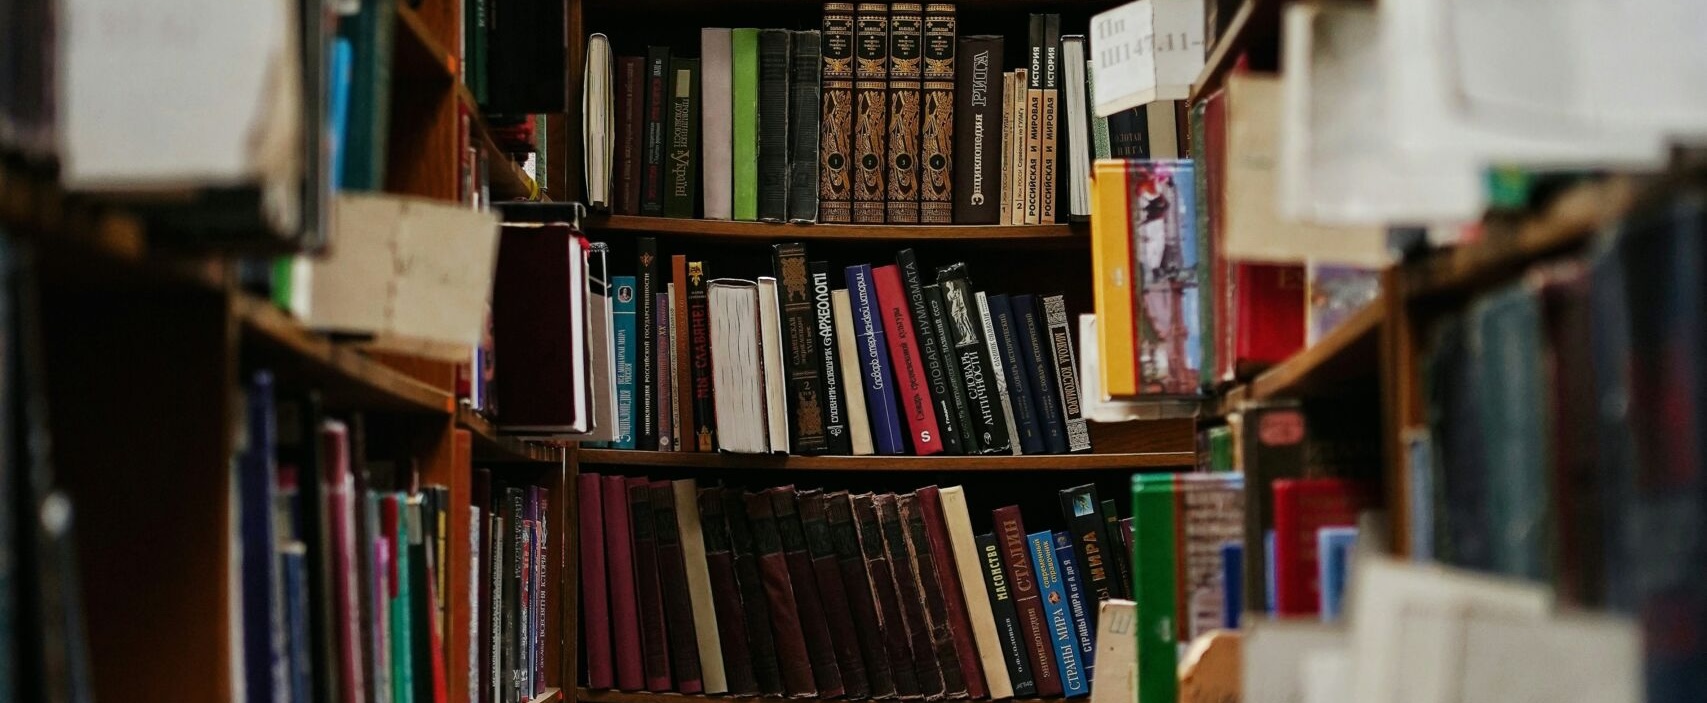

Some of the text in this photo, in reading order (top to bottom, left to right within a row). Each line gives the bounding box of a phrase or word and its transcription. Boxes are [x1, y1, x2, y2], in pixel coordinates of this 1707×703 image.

[1032, 47, 1040, 87] ИСТОРИЯ
[1047, 47, 1055, 87] ИСТОРИЯ
[971, 50, 988, 205] Энциклопедия РИГА
[671, 150, 690, 196] Україні
[1029, 159, 1037, 216] РОССИЙСКАЯ
[1044, 159, 1052, 216] РОССИЙСКАЯ
[1016, 202, 1023, 210] 2
[856, 272, 883, 390] Словарь американской истории
[893, 307, 907, 339] культуры
[905, 262, 945, 394] СЛОВАРЬ НУМИЗМАТА
[931, 300, 940, 316] СССР
[692, 305, 707, 369] СЛАВЯНЕ!
[789, 317, 800, 365] СЛАВЯНСКАЯ
[935, 318, 949, 353] НАЗВАНИЙ
[999, 313, 1022, 392] СЛОВАРЬ ИСТОРИЧЕСКИЙ
[1025, 313, 1042, 363] ИСТОРИЧЕСКИЙ
[803, 380, 811, 391] 2
[824, 347, 838, 423] СЛОВНИК-ДОВІДНИК
[961, 352, 978, 399] СЛОВАРЬ
[969, 351, 993, 425] АНТИЧНОСТИ
[1055, 332, 1079, 415] МИКОЛА КОСТОМАРОВ
[920, 430, 931, 443] S
[986, 545, 1008, 600] МАСОНСТВО
[1003, 520, 1031, 592] СТАЛИН
[1033, 538, 1050, 588] современный
[1066, 566, 1075, 575] до
[1083, 531, 1106, 581] МИРА
[1070, 584, 1078, 592] от
[1071, 593, 1084, 617] МИРА
[1028, 608, 1050, 678] ЭНЦИКЛОПЕДИЯ
[1053, 608, 1080, 690] СТРАНЫ МИРА
[1077, 618, 1092, 652] СТРАНЫ
